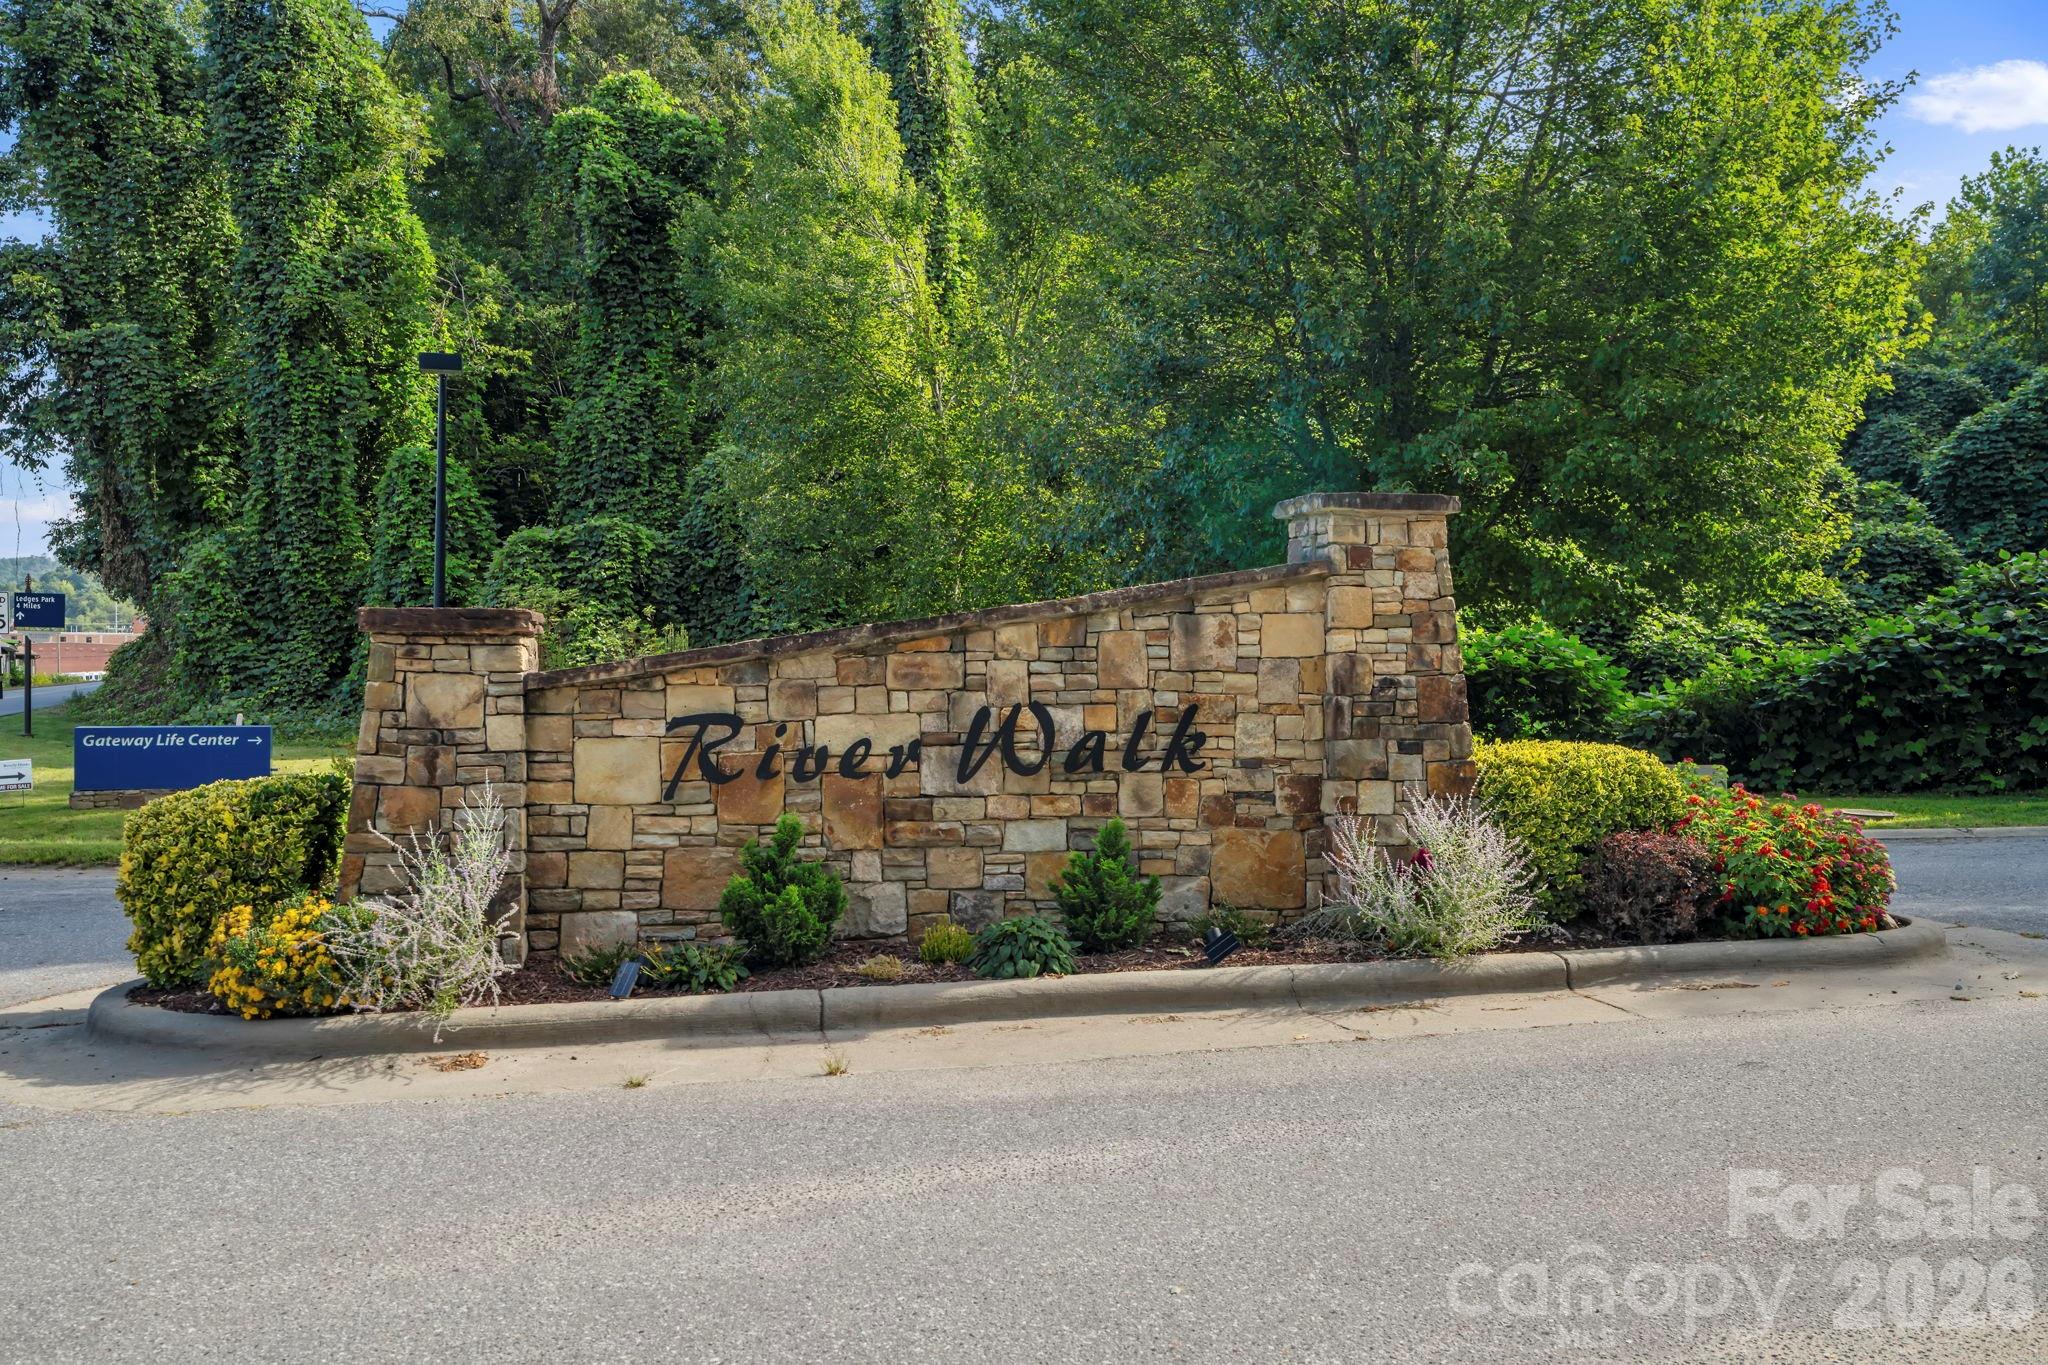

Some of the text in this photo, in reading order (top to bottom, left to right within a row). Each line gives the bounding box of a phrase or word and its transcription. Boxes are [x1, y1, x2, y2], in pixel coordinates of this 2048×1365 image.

[16, 596, 39, 604] Ledges
[82, 733, 240, 750] Gateway Life Center
[663, 700, 1208, 801] River Walk
